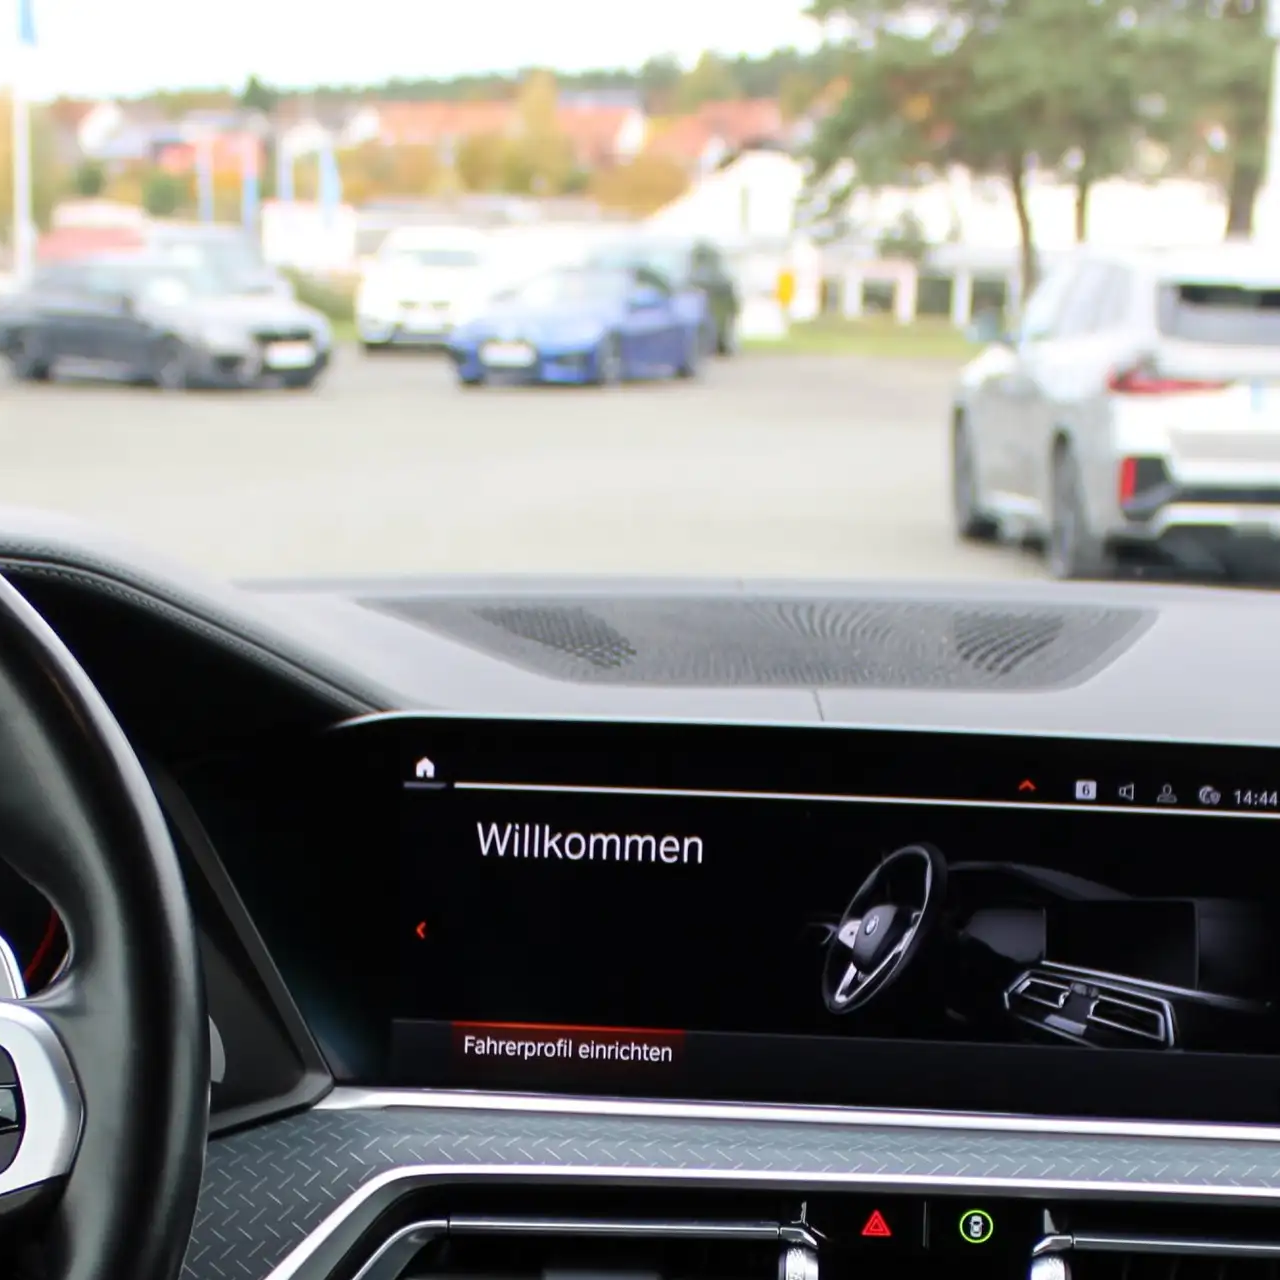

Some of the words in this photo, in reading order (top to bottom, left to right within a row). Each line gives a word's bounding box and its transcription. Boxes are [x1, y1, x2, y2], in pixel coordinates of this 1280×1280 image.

[1234, 789, 1278, 806] 14:44
[476, 822, 703, 864] Willkommen
[463, 1035, 572, 1060] Fahrerprofil
[578, 1040, 673, 1062] einrichten
